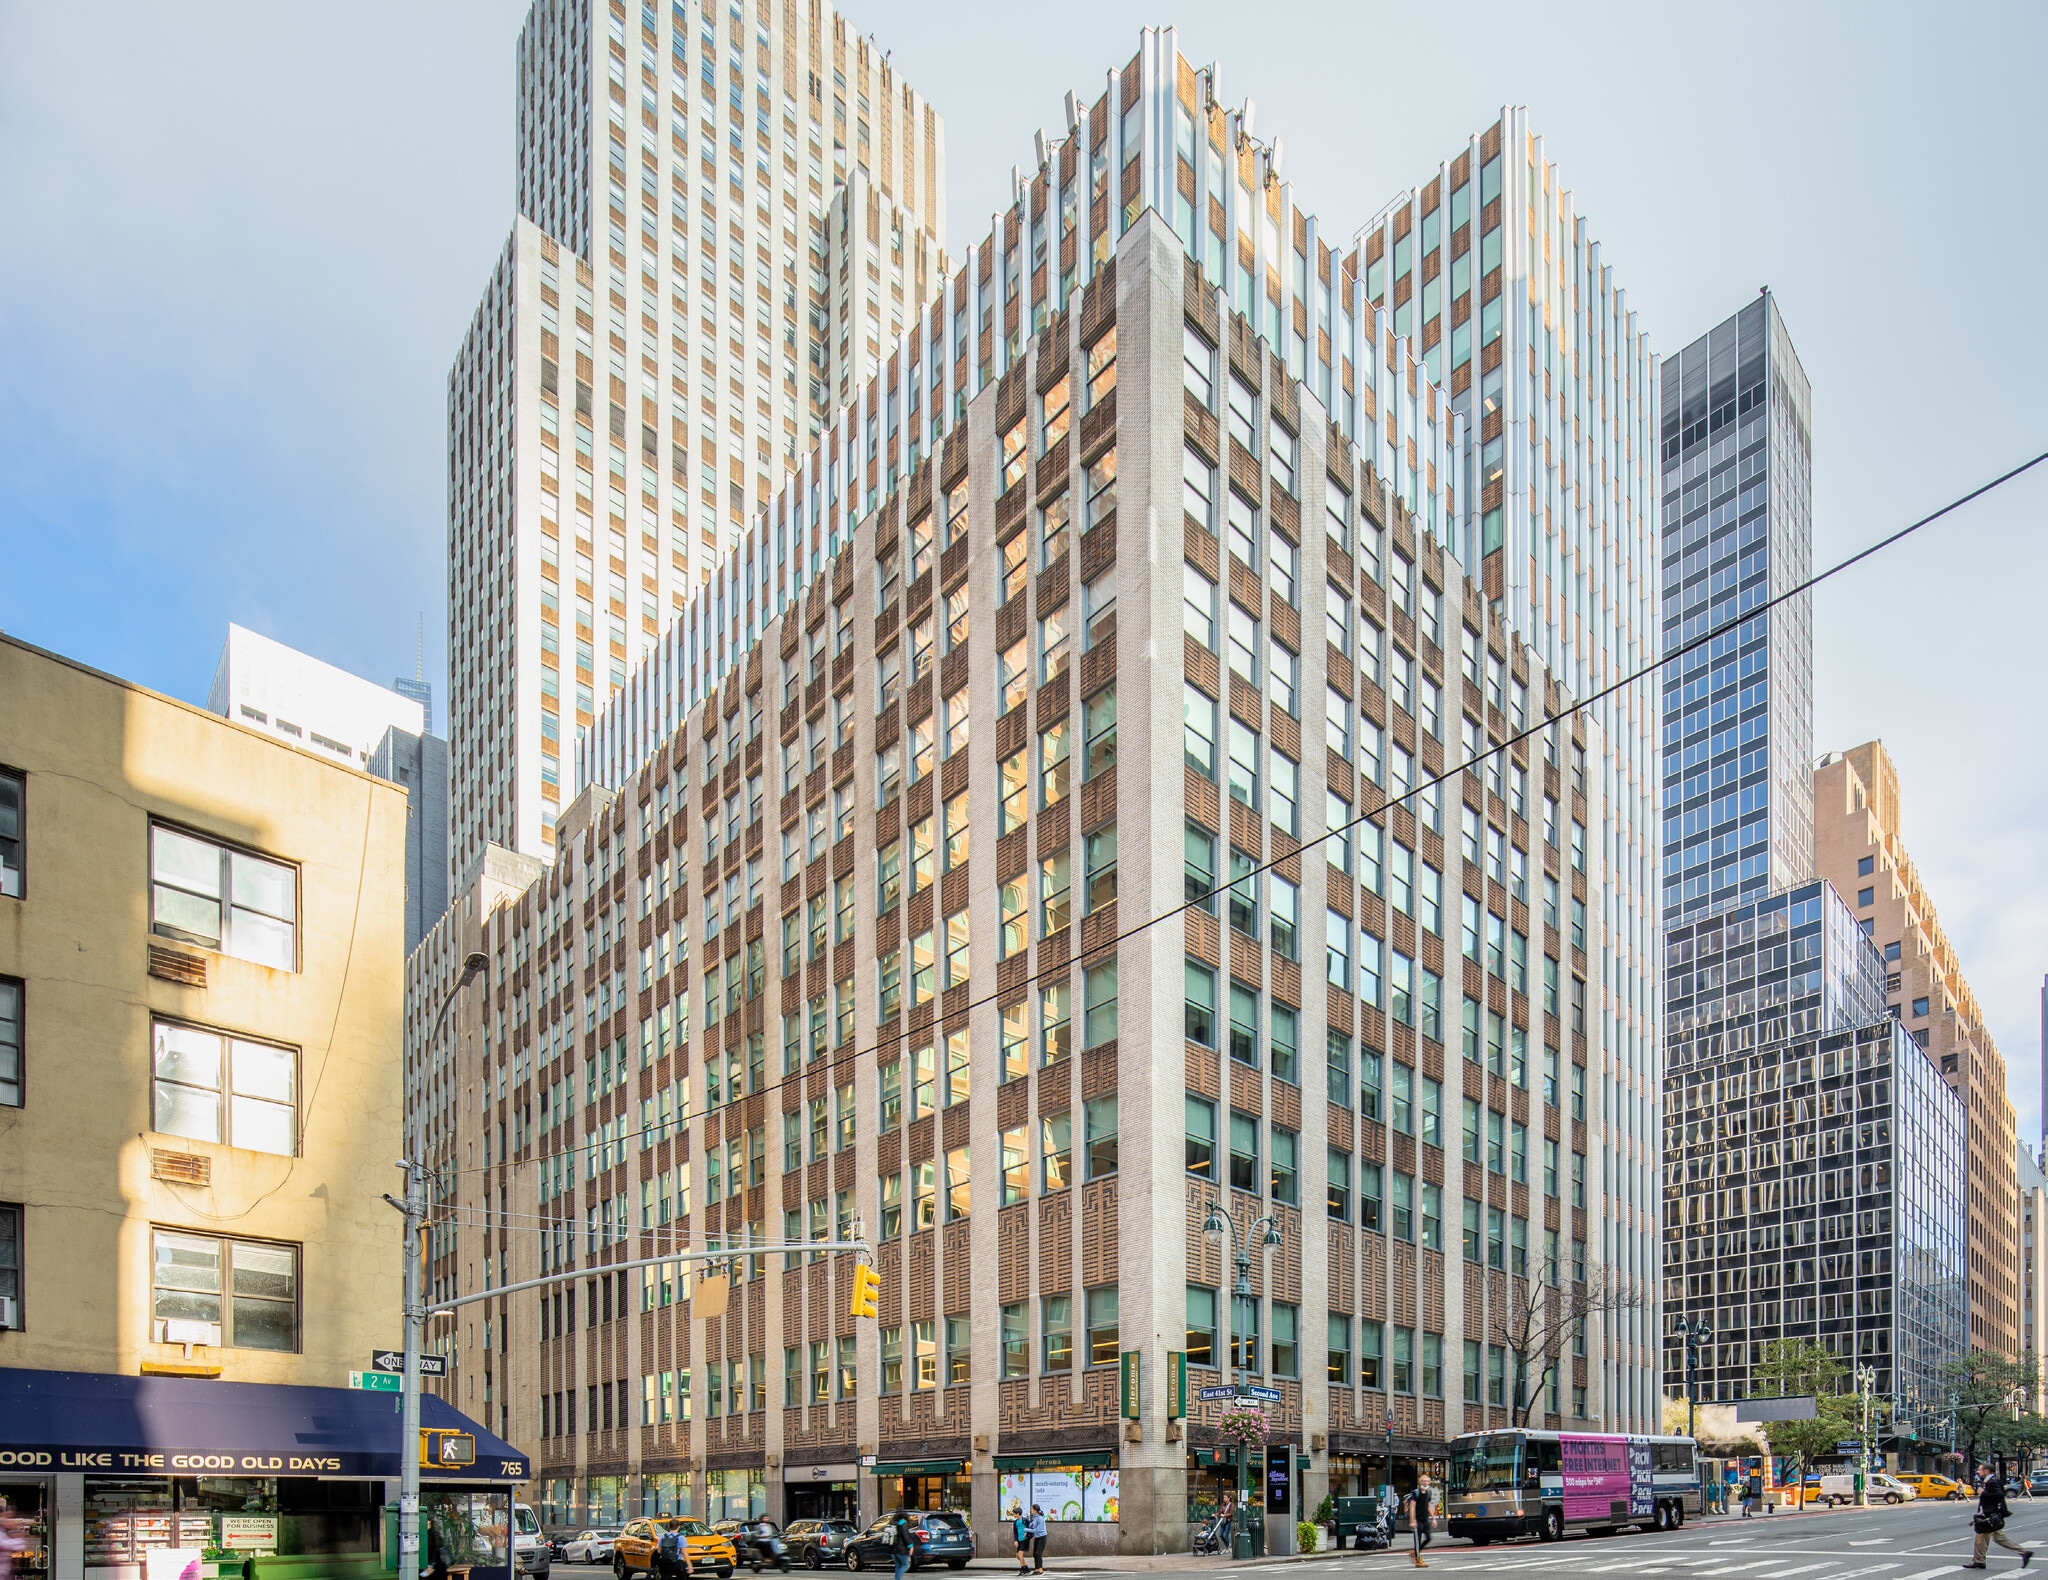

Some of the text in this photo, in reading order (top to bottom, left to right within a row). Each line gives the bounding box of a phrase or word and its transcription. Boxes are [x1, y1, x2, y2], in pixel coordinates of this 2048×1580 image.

[383, 1356, 404, 1367] ONE
[370, 1375, 392, 1388] 2 Av
[1129, 1363, 1137, 1407] pleroma
[1169, 1363, 1177, 1407] pleroma
[1214, 1389, 1226, 1397] 41st
[1250, 1388, 1279, 1400] Second Ave
[1563, 1441, 1605, 1456] 2 MONTHS
[0, 1451, 341, 1470] OOD LIKE THE GOOD OLD DAYS
[1036, 1459, 1062, 1467] pleroma
[1564, 1458, 1622, 1472] FREE INTERNET
[1635, 1452, 1650, 1465] RCN
[501, 1461, 522, 1476] 765
[1566, 1477, 1574, 1486] 500
[1637, 1470, 1651, 1483] RCN
[1035, 1480, 1068, 1488] mouth-watering
[1638, 1487, 1652, 1500] RCN
